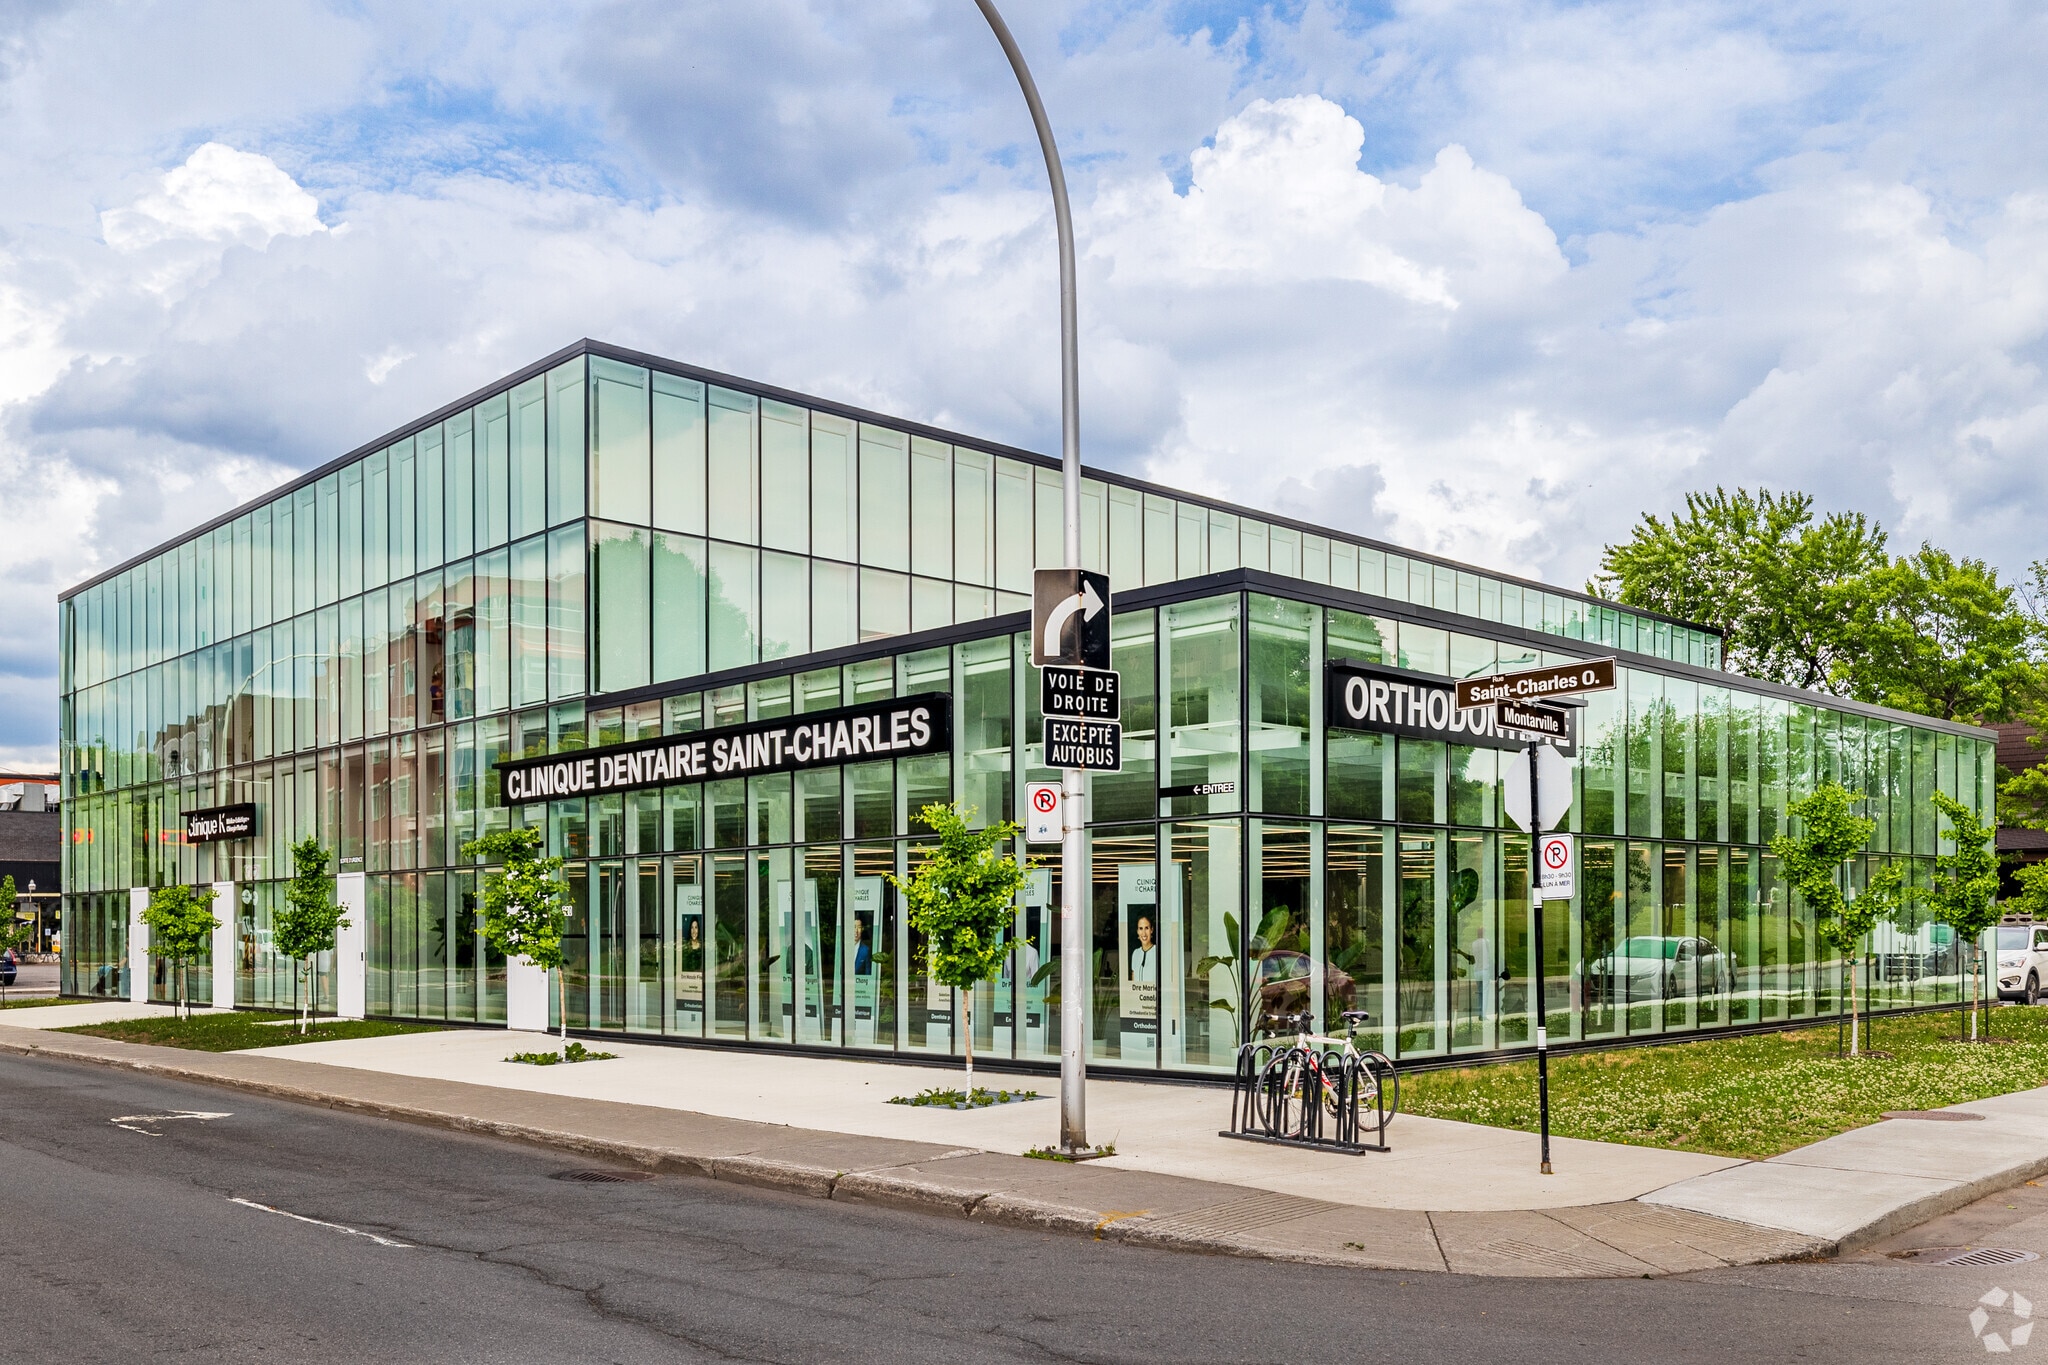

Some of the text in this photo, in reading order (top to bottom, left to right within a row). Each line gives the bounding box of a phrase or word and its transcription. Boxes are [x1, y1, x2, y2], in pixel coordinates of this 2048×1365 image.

[1048, 673, 1114, 693] VOIE DE
[1470, 669, 1600, 702] Saint-Charles O.
[1053, 694, 1108, 713] DROITE
[1504, 707, 1559, 732] Montarville
[1053, 724, 1113, 745] EXCEPTÉ
[507, 707, 931, 800] CLINIQUE DENTAIRE SAINT-CHARLES
[1052, 744, 1114, 766] AUTOBUS
[1136, 878, 1156, 886] CLINIQ
[1133, 1022, 1157, 1030] Orthodon
